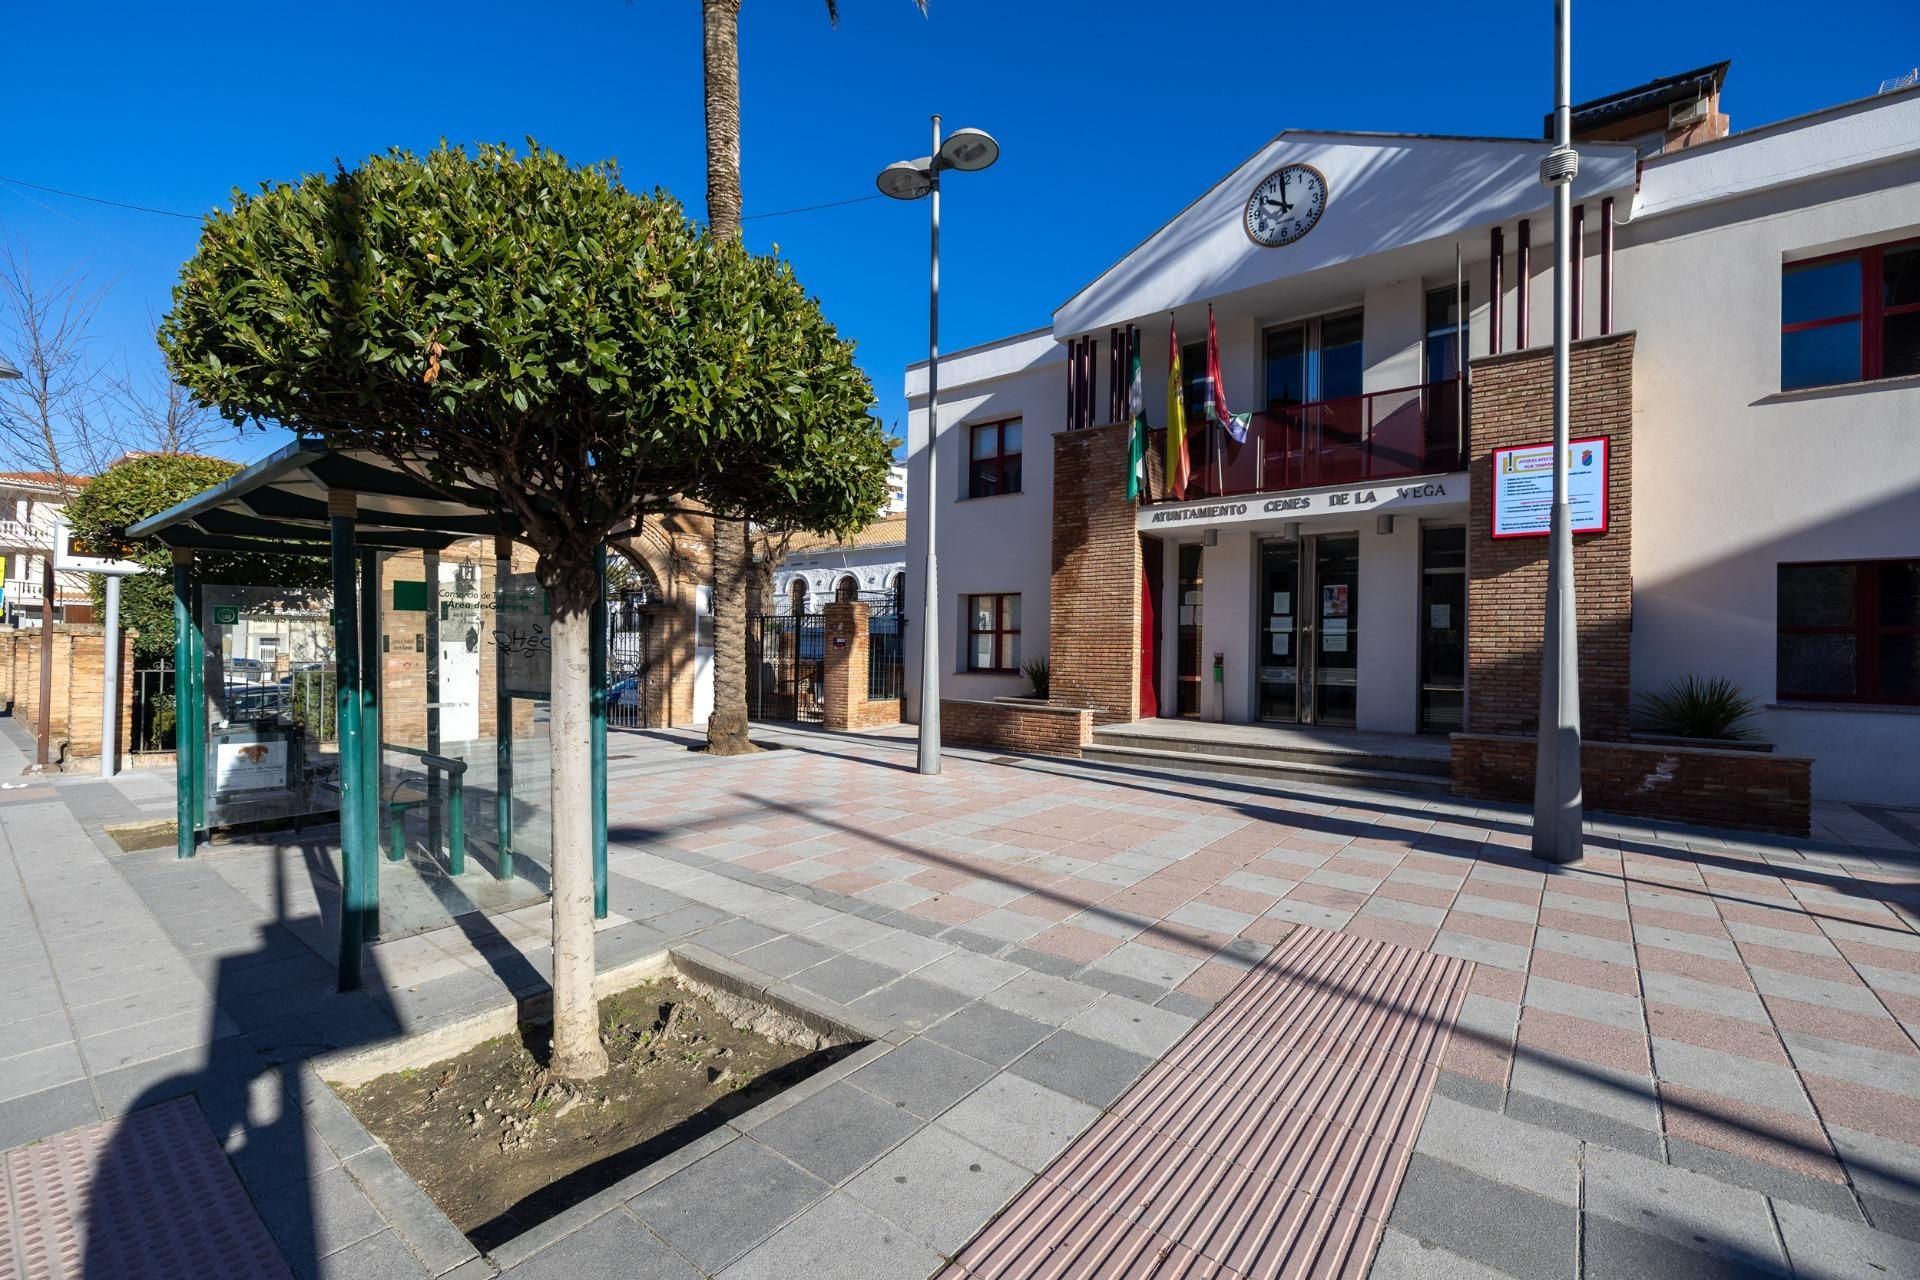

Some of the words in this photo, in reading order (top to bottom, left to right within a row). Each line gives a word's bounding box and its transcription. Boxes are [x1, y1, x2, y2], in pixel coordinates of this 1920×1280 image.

[1298, 175, 1302, 184] 1
[1308, 179, 1315, 190] 2
[1269, 184, 1276, 194] 11
[1312, 193, 1319, 203] 3
[1253, 210, 1260, 220] 9
[1306, 208, 1312, 218] 4
[1258, 222, 1265, 232] 8
[1295, 220, 1301, 231] 5
[1269, 228, 1275, 238] 7
[1281, 227, 1287, 237] 6
[1151, 502, 1247, 523] AYUNTAMIENTO
[1263, 497, 1311, 513] CENES
[1328, 492, 1350, 507] DE
[1354, 489, 1377, 504] LA
[1397, 484, 1446, 499] VEGA
[438, 589, 479, 599] Consorcio
[480, 590, 491, 599] de
[447, 597, 471, 609] Área
[474, 601, 486, 609] de
